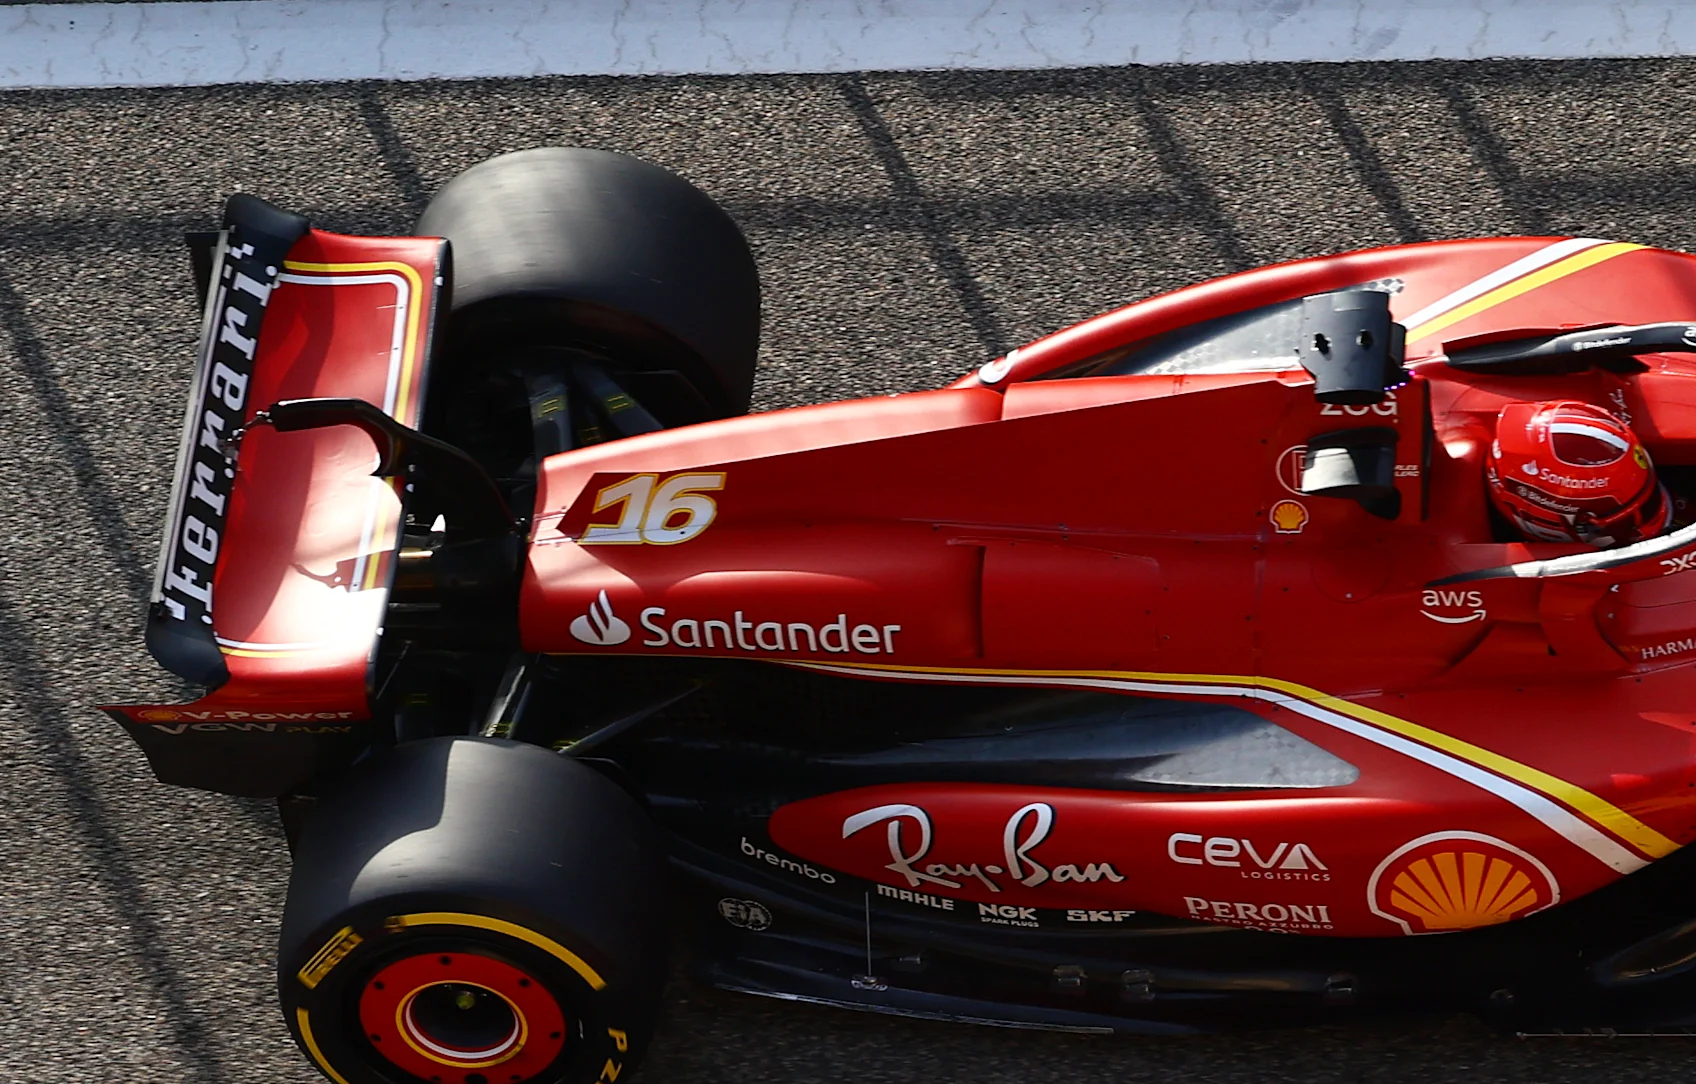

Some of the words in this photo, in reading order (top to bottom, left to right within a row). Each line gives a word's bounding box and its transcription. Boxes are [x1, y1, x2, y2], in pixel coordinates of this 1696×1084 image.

[164, 264, 273, 613] Ferrari
[1538, 467, 1610, 489] Santander
[577, 472, 727, 545] 16
[640, 606, 901, 654] Santander
[184, 710, 353, 720] V-Power
[152, 723, 277, 735] VGW
[740, 836, 836, 884] brembo
[1241, 871, 1331, 881] LOGISTICS
[877, 884, 954, 911] MAHLE
[978, 903, 1037, 920] NGK
[1067, 910, 1136, 922] SKF
[1183, 896, 1332, 923] PERONI
[981, 917, 1010, 925] SPARK
[1011, 920, 1039, 928] PLUGS
[607, 1027, 628, 1052] P
